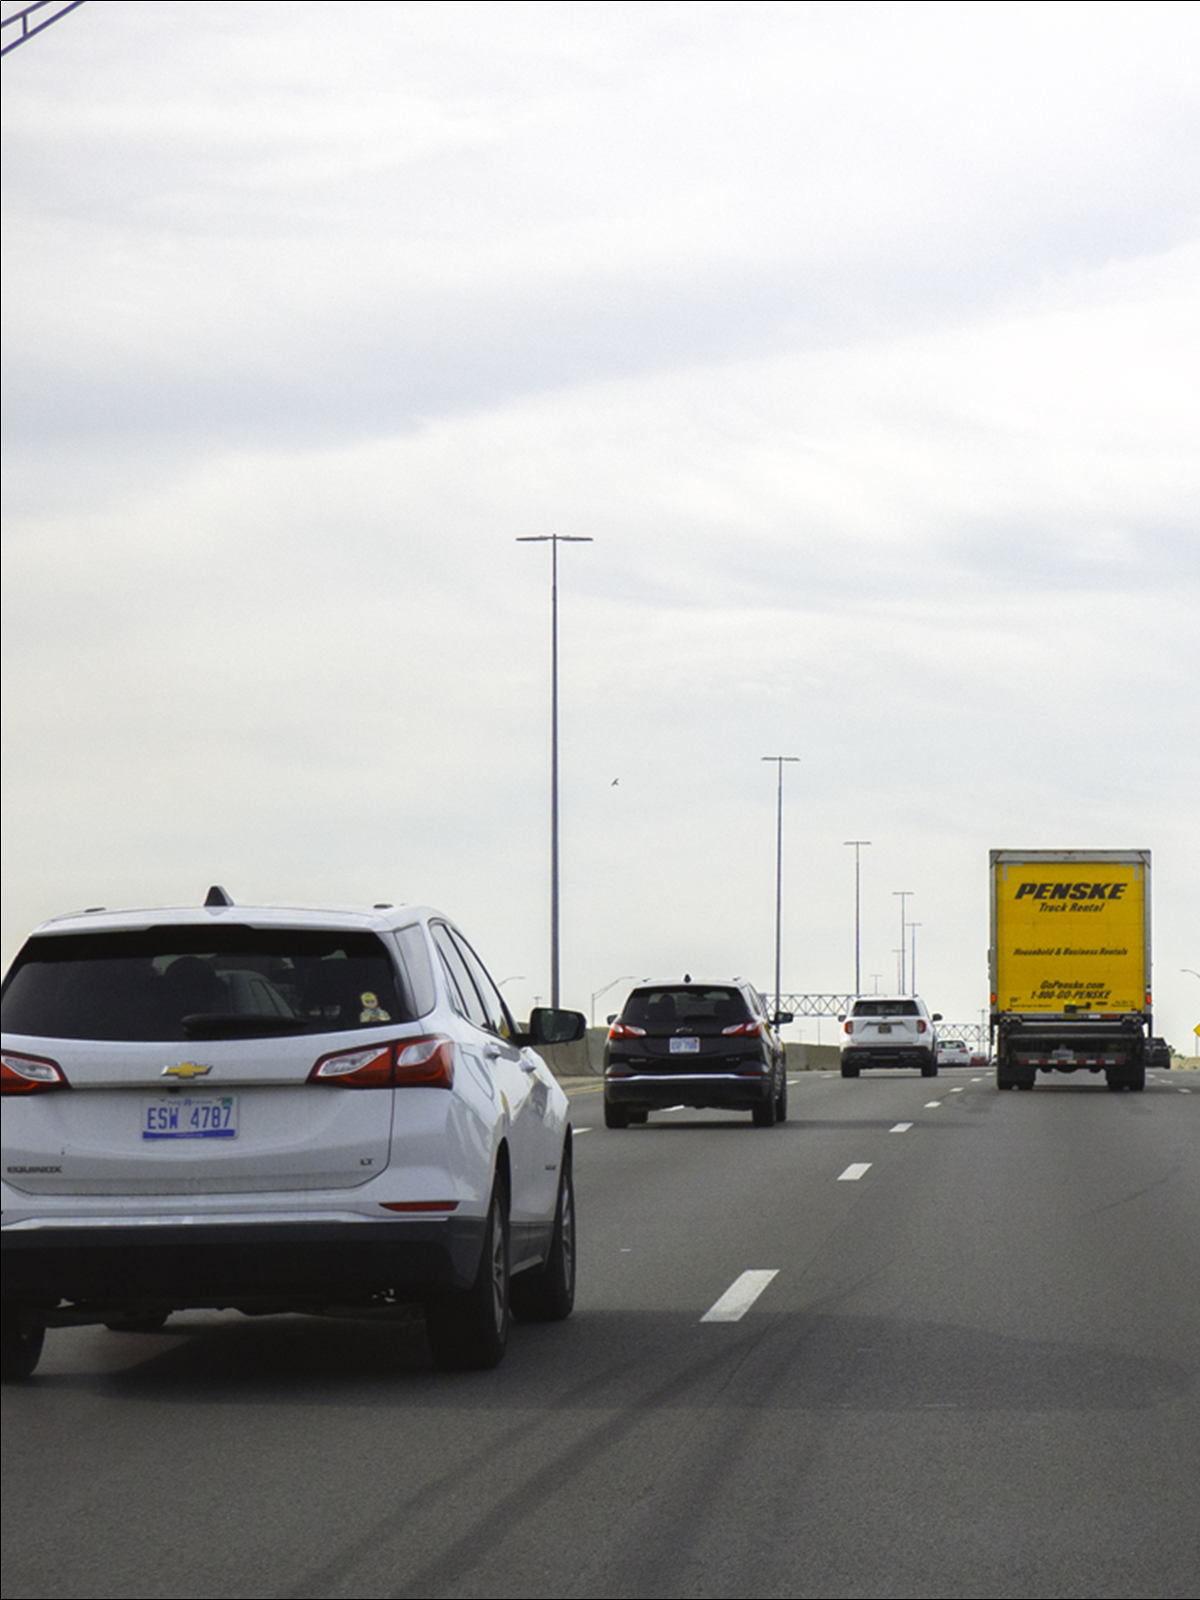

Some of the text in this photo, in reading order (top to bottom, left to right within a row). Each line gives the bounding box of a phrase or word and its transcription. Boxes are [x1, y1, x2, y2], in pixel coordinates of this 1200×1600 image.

[1014, 882, 1128, 900] PENSKE
[1039, 902, 1105, 913] Truck Rental
[1013, 947, 1055, 956] Household
[1063, 947, 1098, 956] Business
[1099, 947, 1128, 956] Rentals
[1040, 980, 1105, 989] GoPenske.com
[1030, 990, 1112, 999] 1-800-GO-PENSKE
[147, 1106, 232, 1130] ESW 4787
[7, 1165, 62, 1174] EQUINOX
